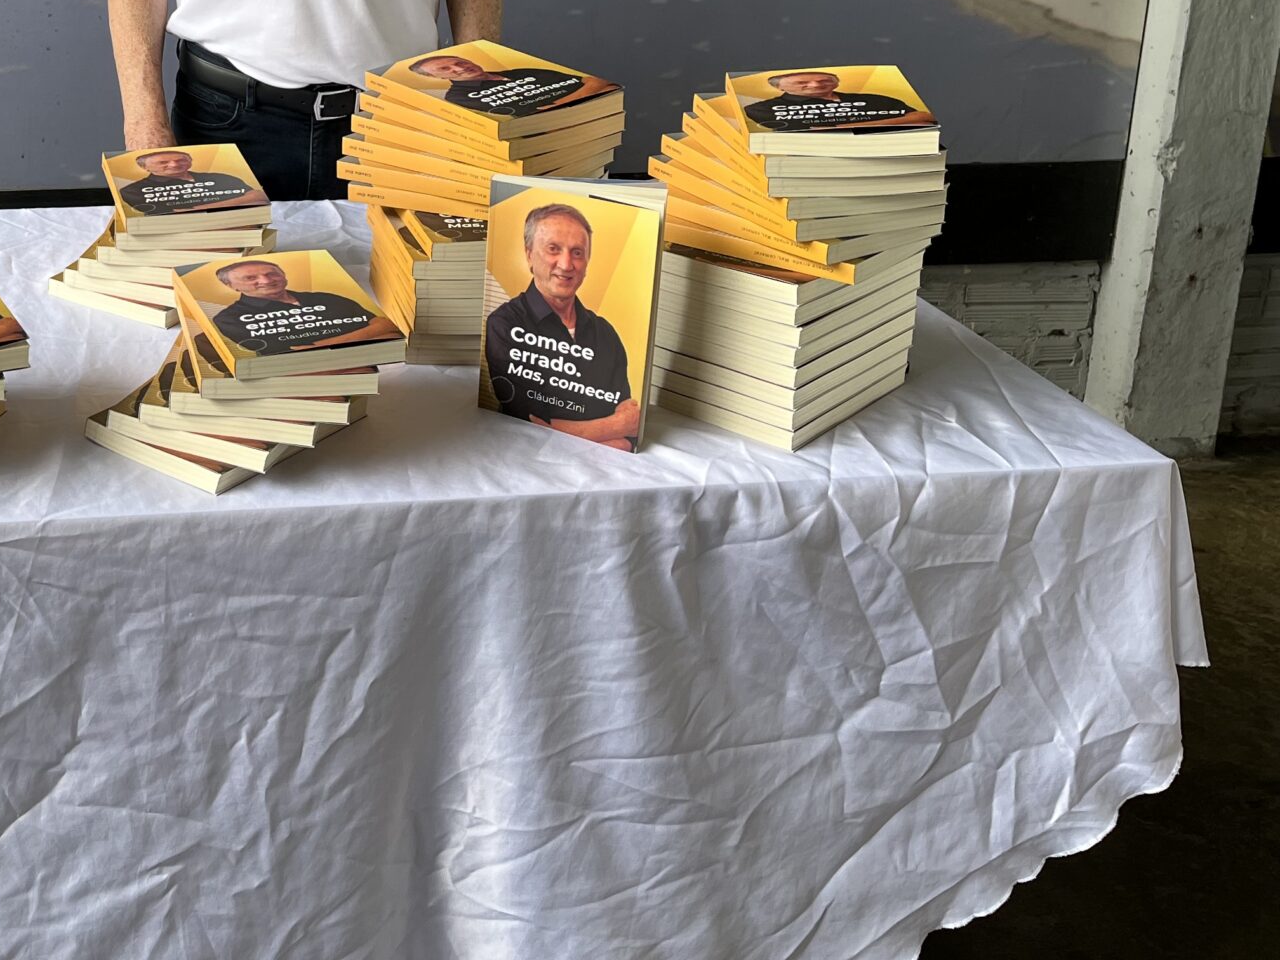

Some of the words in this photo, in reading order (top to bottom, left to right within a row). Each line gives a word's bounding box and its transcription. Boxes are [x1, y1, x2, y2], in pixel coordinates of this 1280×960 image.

[468, 77, 536, 98] Comece
[481, 84, 541, 103] errado.
[489, 96, 523, 107] Mas,
[524, 78, 579, 96] comece!
[772, 102, 866, 110] Comece
[774, 107, 857, 116] errado.
[142, 182, 215, 192] Comece
[144, 188, 208, 198] errado.
[183, 189, 245, 198] comece!
[240, 305, 326, 322] Comece
[246, 314, 322, 330] errado.
[250, 328, 290, 337] Mas,
[295, 315, 368, 330] comece!
[278, 331, 320, 341] Cláudio
[511, 327, 594, 360] Comece
[509, 348, 581, 377] errado.
[508, 363, 544, 385] Mas,
[549, 376, 620, 404] comece!
[527, 390, 564, 407] Cláudio
[566, 401, 585, 413] Zini
